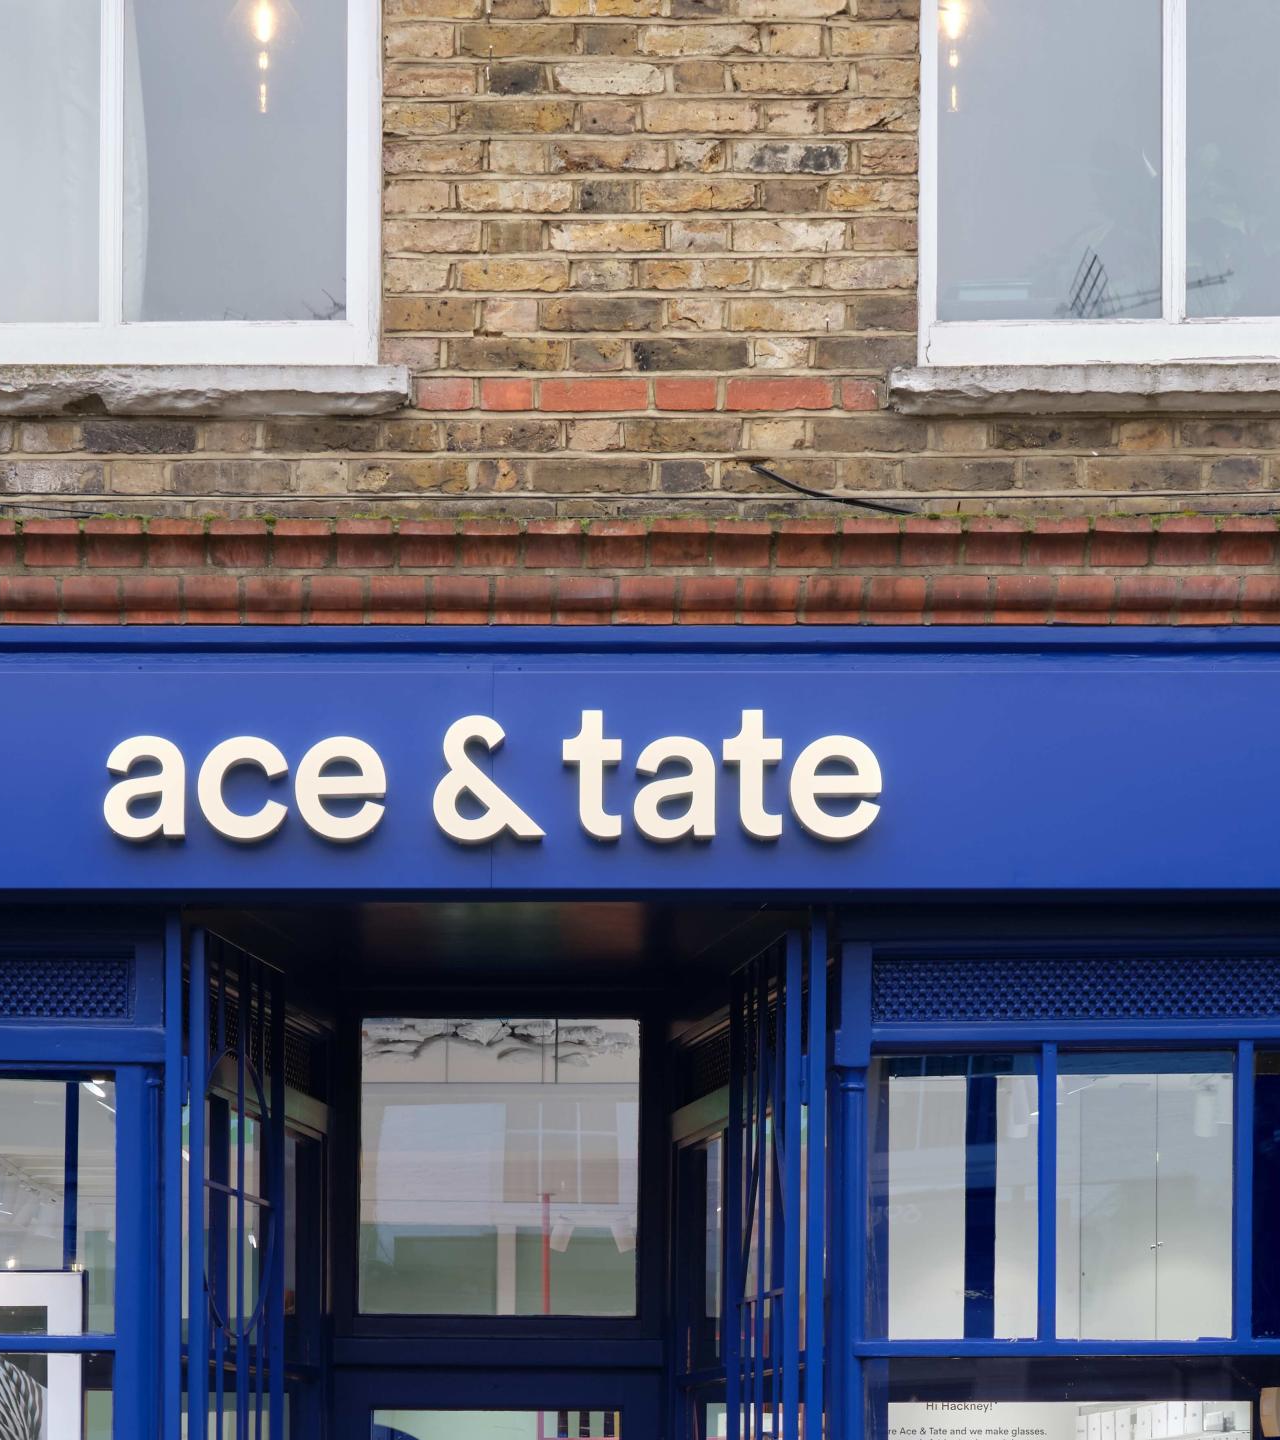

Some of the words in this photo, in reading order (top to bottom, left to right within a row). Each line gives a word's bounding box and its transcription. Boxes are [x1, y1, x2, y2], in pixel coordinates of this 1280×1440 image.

[103, 735, 387, 843] ace
[432, 715, 546, 844] &
[563, 710, 882, 843] tate
[941, 1402, 993, 1412] Hackney!
[1011, 1428, 1047, 1438] glasses.
